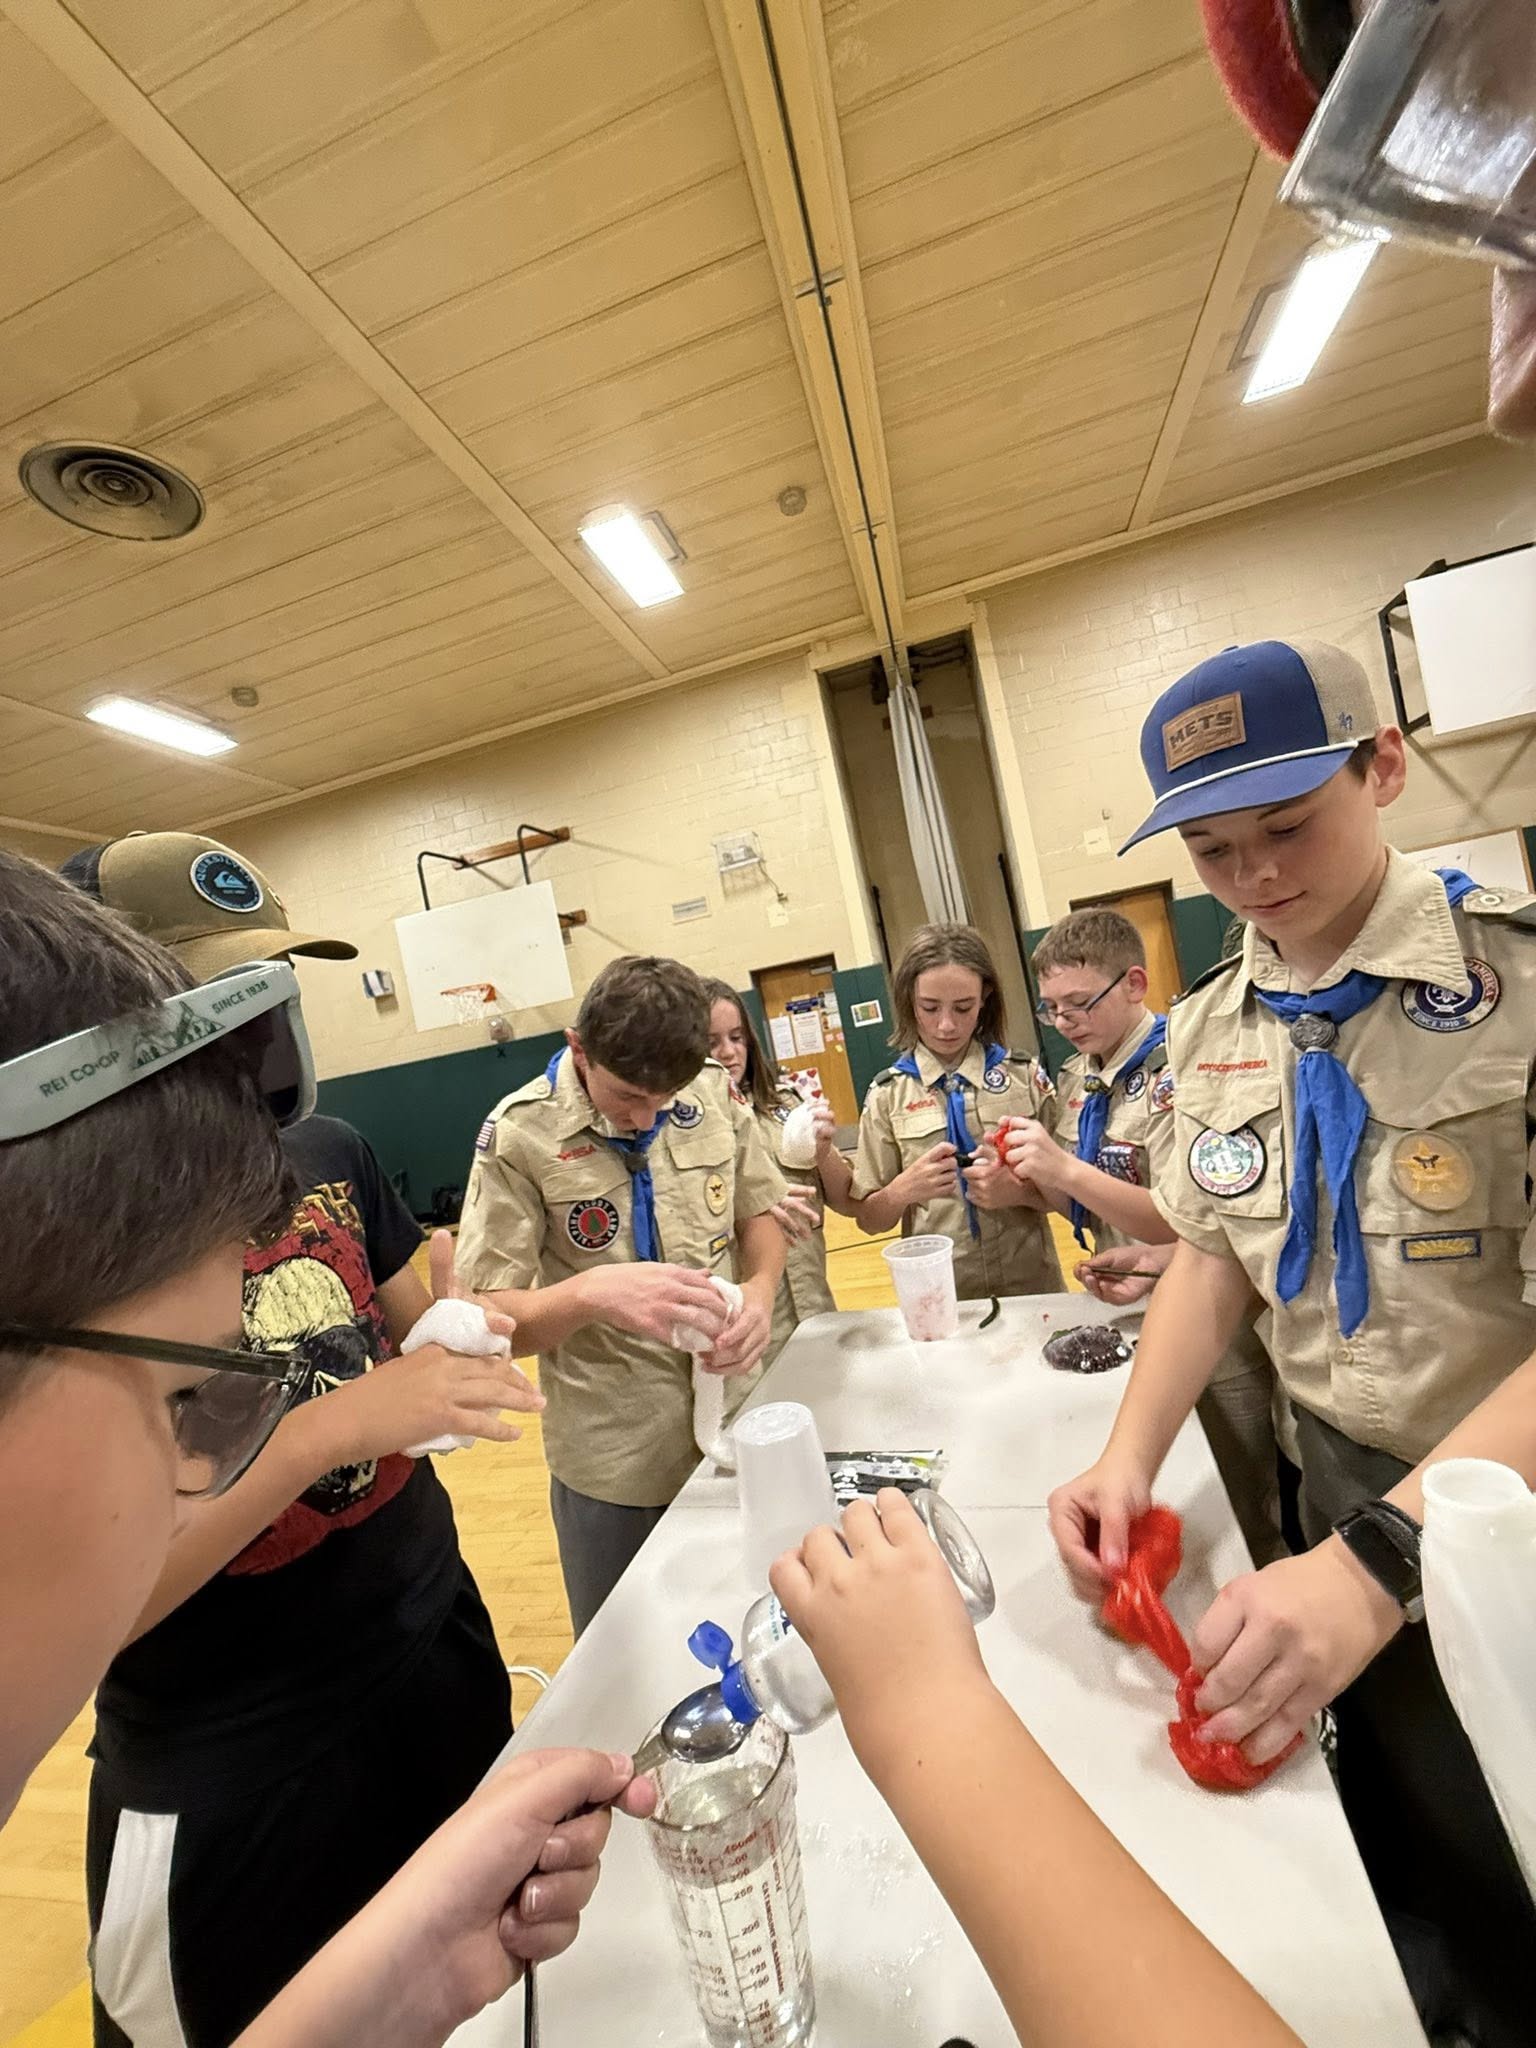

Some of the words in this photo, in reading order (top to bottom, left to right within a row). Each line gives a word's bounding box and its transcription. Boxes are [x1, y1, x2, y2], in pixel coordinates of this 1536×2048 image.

[1169, 710, 1234, 750] METS
[211, 990, 245, 1015] SINCE
[245, 979, 269, 998] 1938
[1412, 1011, 1438, 1027] SINCE
[1439, 1020, 1461, 1028] 1910
[39, 1077, 68, 1097] REI
[733, 1884, 754, 1901] 250
[741, 1919, 761, 1936] 200
[749, 1960, 768, 1976] 125
